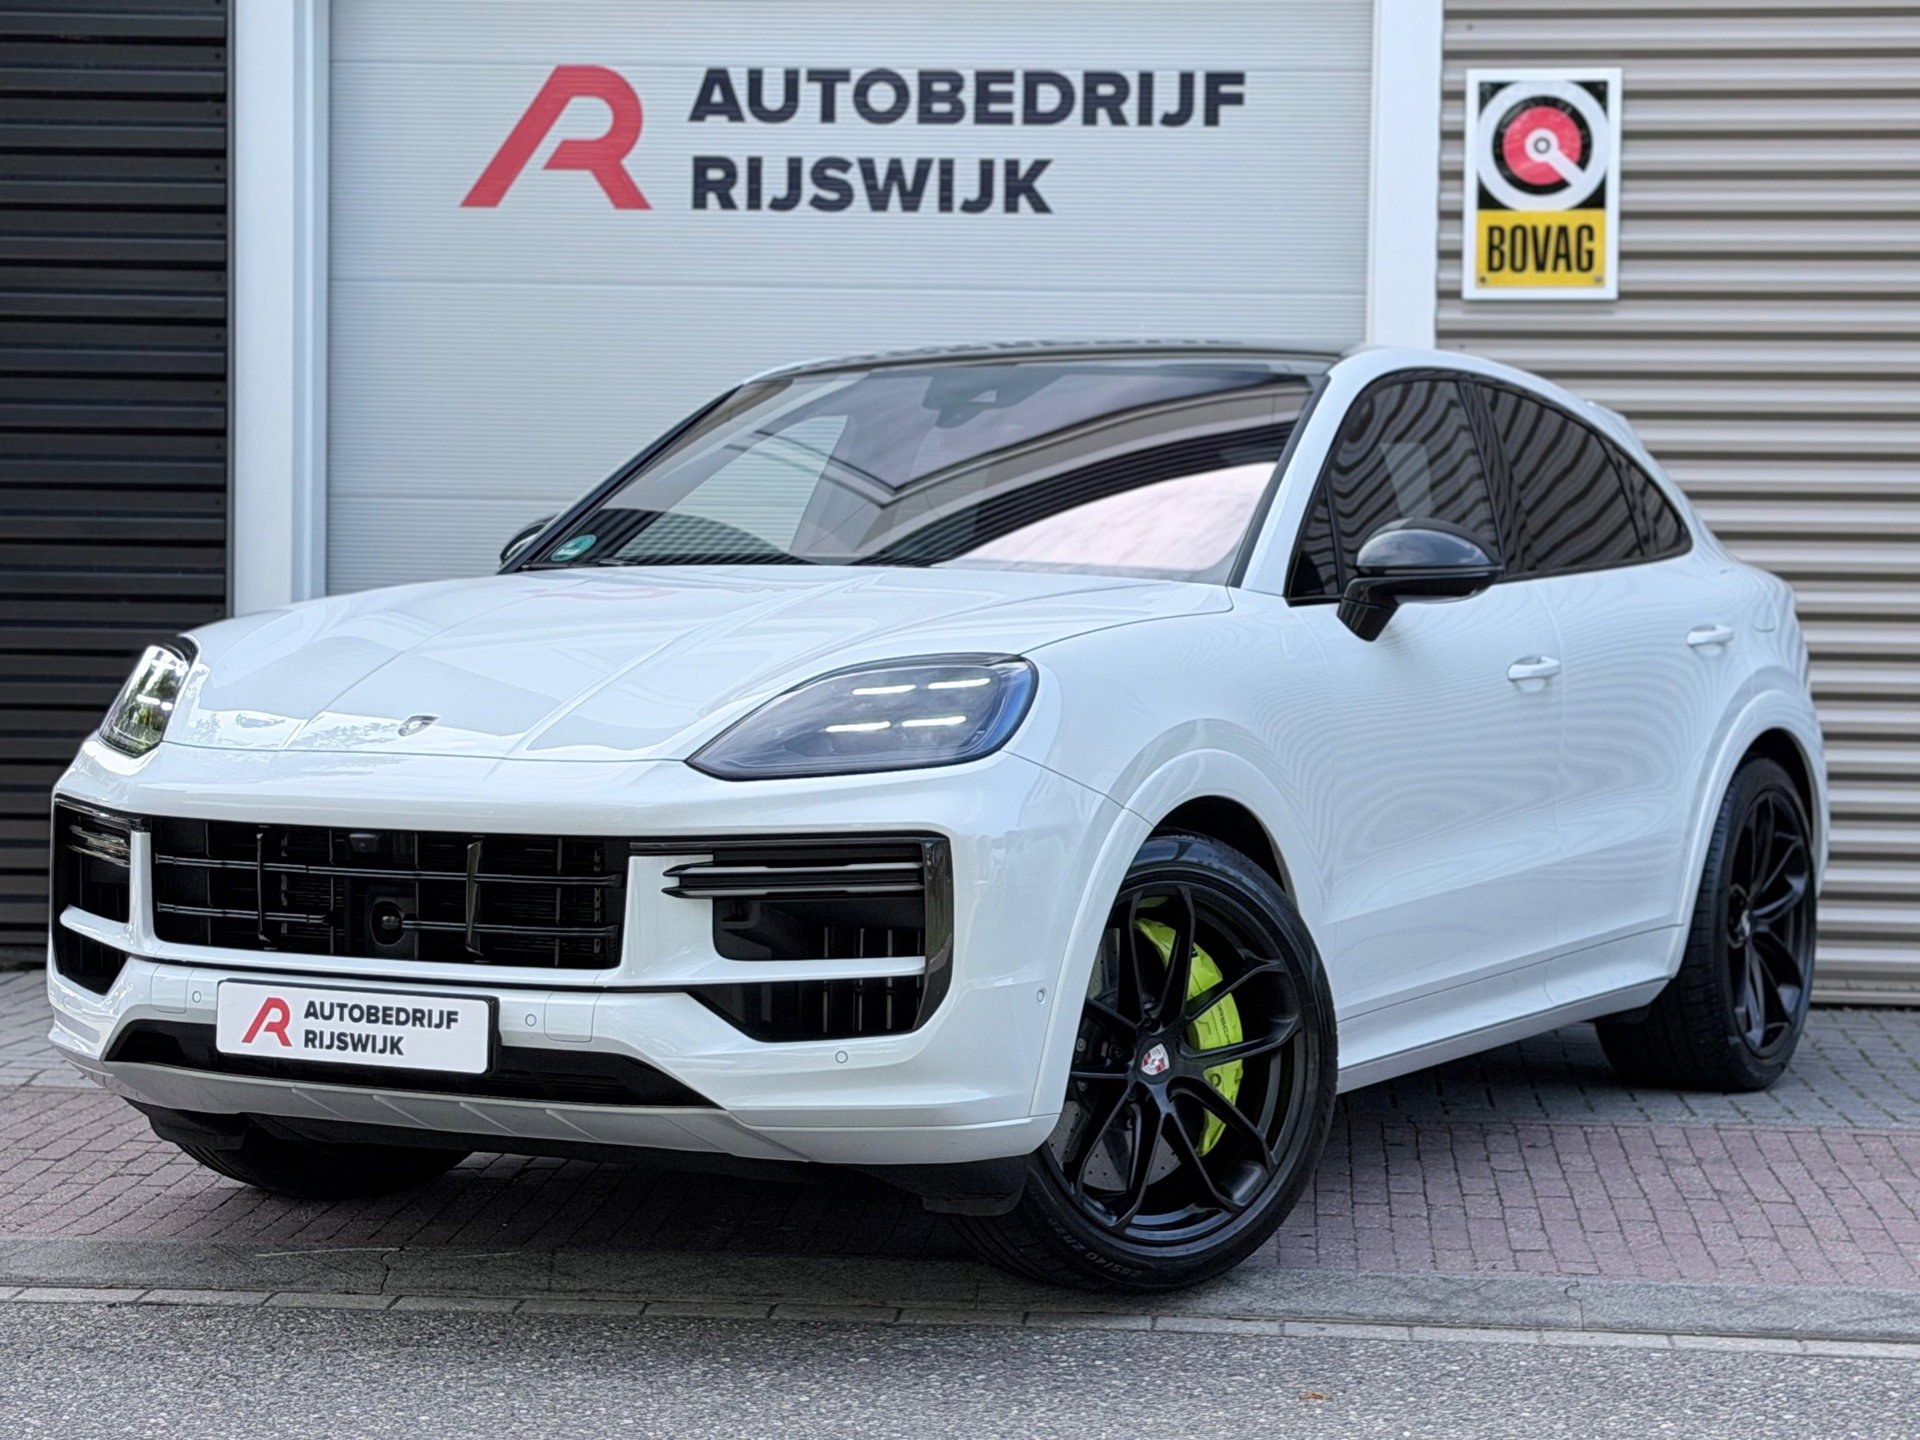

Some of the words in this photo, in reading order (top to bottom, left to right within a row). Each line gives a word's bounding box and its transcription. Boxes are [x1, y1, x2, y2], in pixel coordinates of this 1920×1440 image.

[688, 68, 1246, 127] AUTOBEDRIJF
[692, 155, 1053, 214] RIJSWIJK
[1486, 223, 1595, 274] BOVAG
[303, 999, 460, 1030] AUTOBEDRIJF
[303, 1029, 405, 1056] RIJSWIJK
